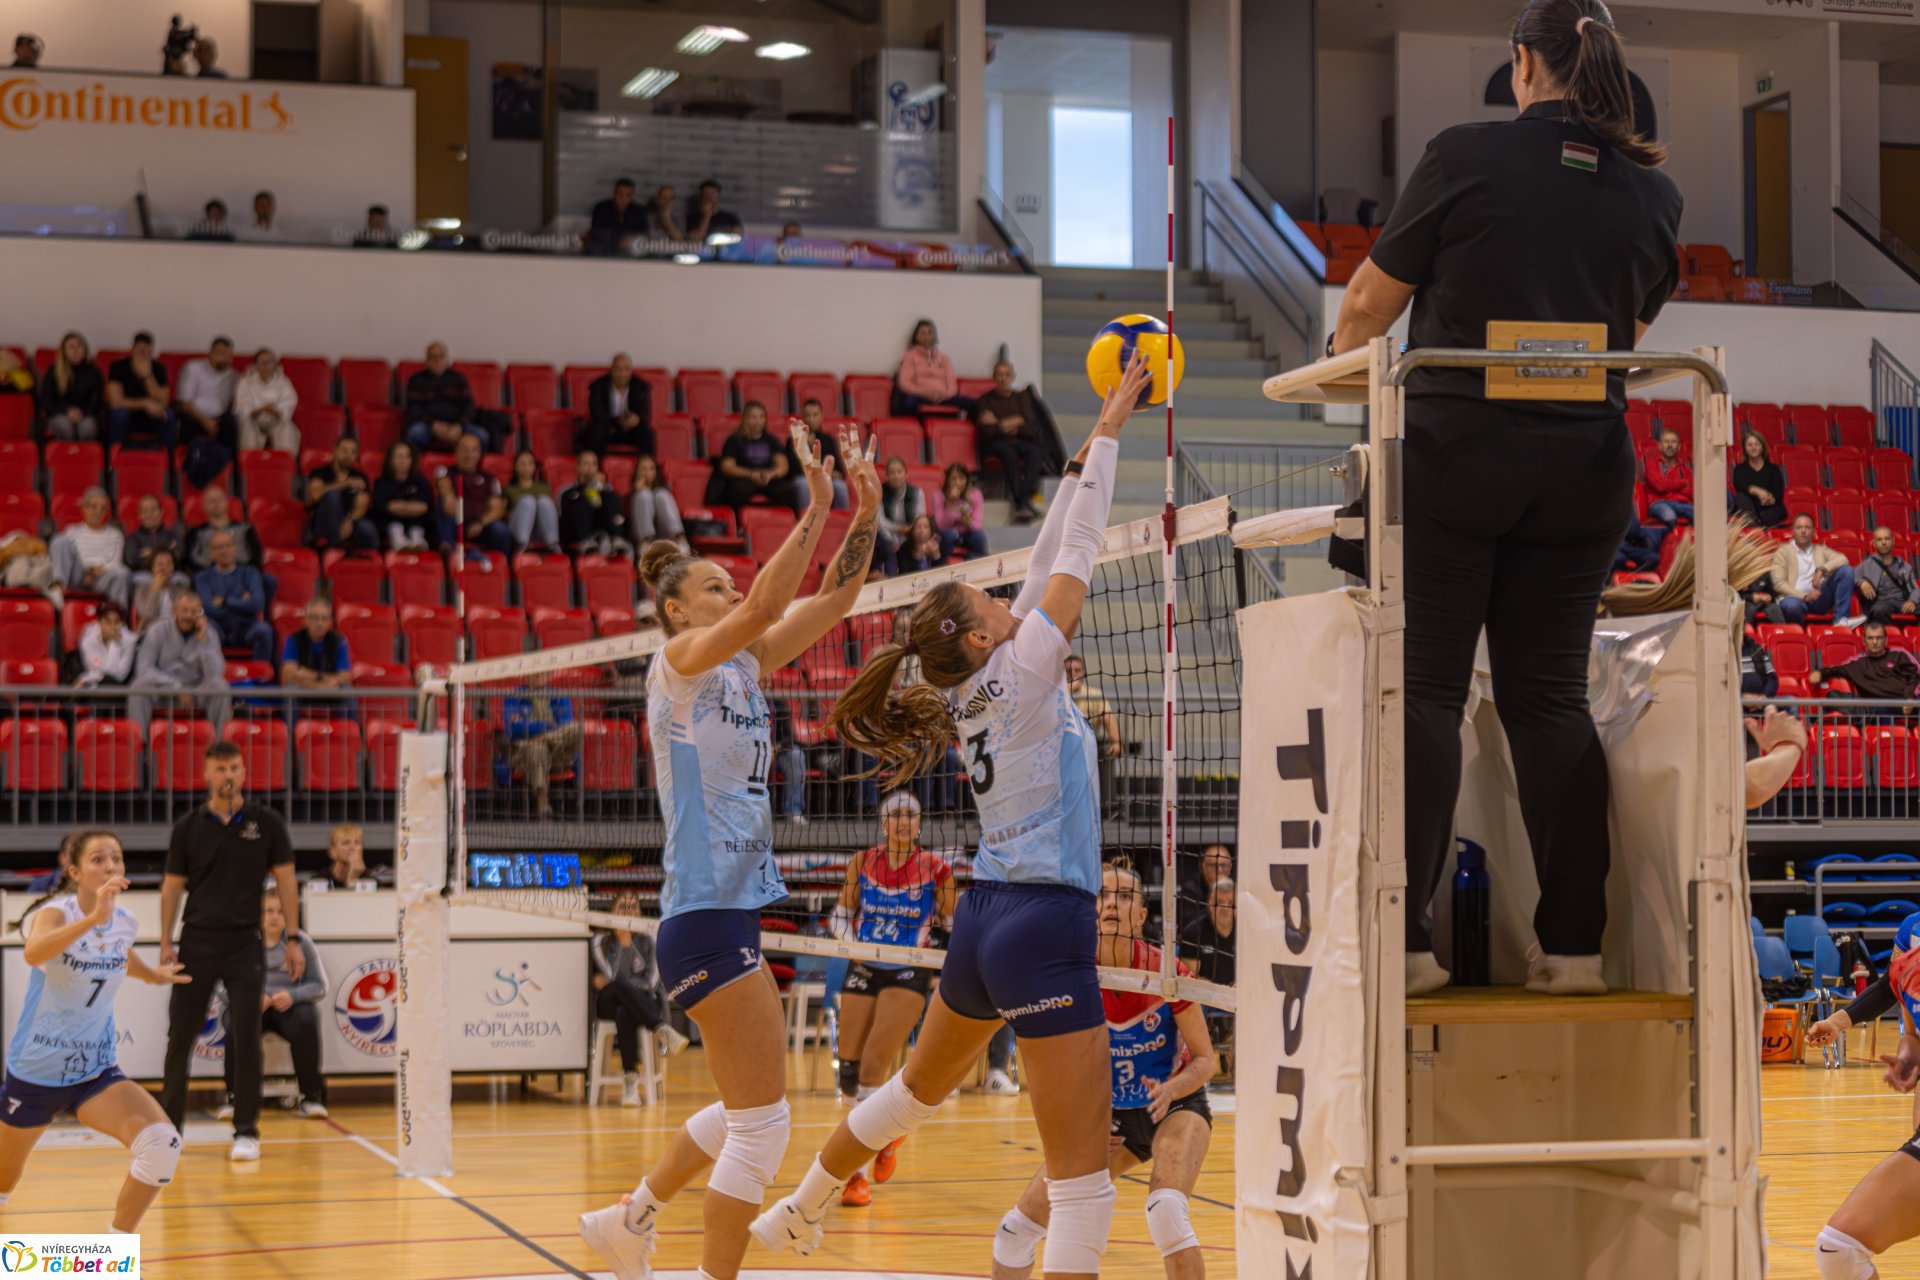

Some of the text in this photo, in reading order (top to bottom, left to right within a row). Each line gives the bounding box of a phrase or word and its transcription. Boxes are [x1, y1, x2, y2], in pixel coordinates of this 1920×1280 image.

[0, 77, 250, 131] Continental
[747, 739, 768, 784] 11
[966, 727, 995, 795] 3
[872, 916, 900, 942] 24
[360, 960, 396, 976] FATU
[85, 978, 107, 1008] 7
[464, 1020, 562, 1038] RÖPLABDA
[1110, 1034, 1166, 1057] mixPRO
[1115, 1061, 1134, 1085] 3
[7, 1097, 21, 1115] 7
